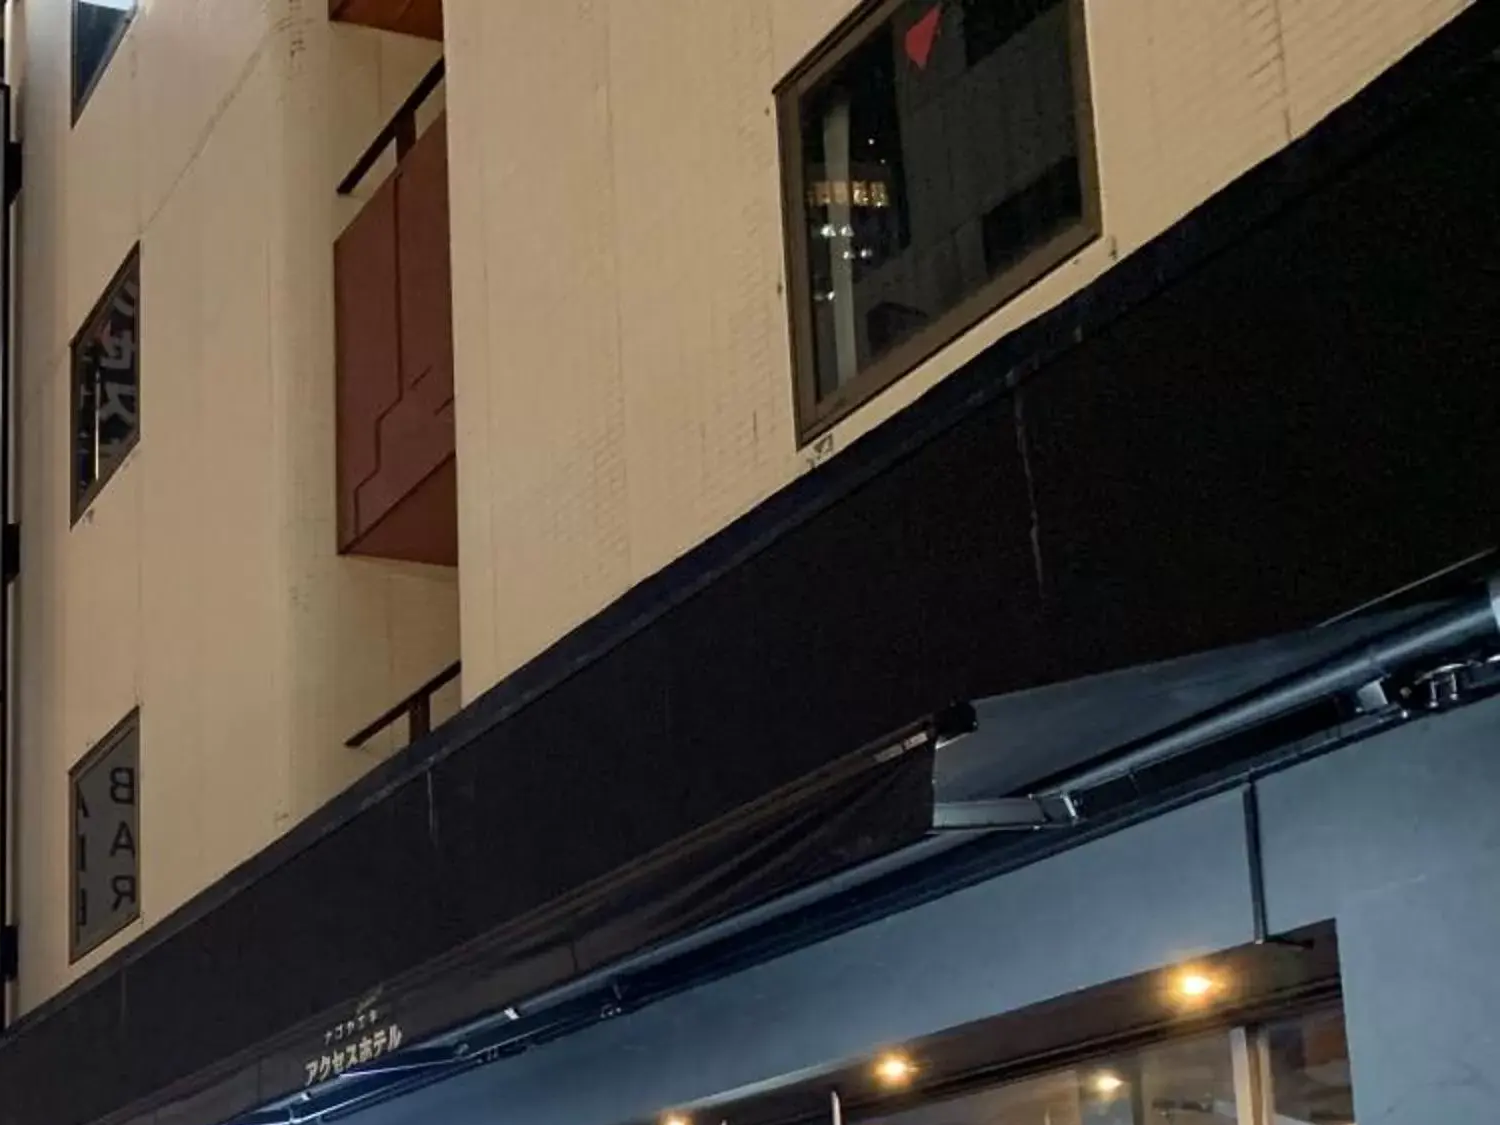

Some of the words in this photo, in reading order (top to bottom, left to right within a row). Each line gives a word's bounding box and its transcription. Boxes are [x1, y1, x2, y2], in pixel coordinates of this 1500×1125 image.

[304, 1024, 403, 1087] アクセスホテル
